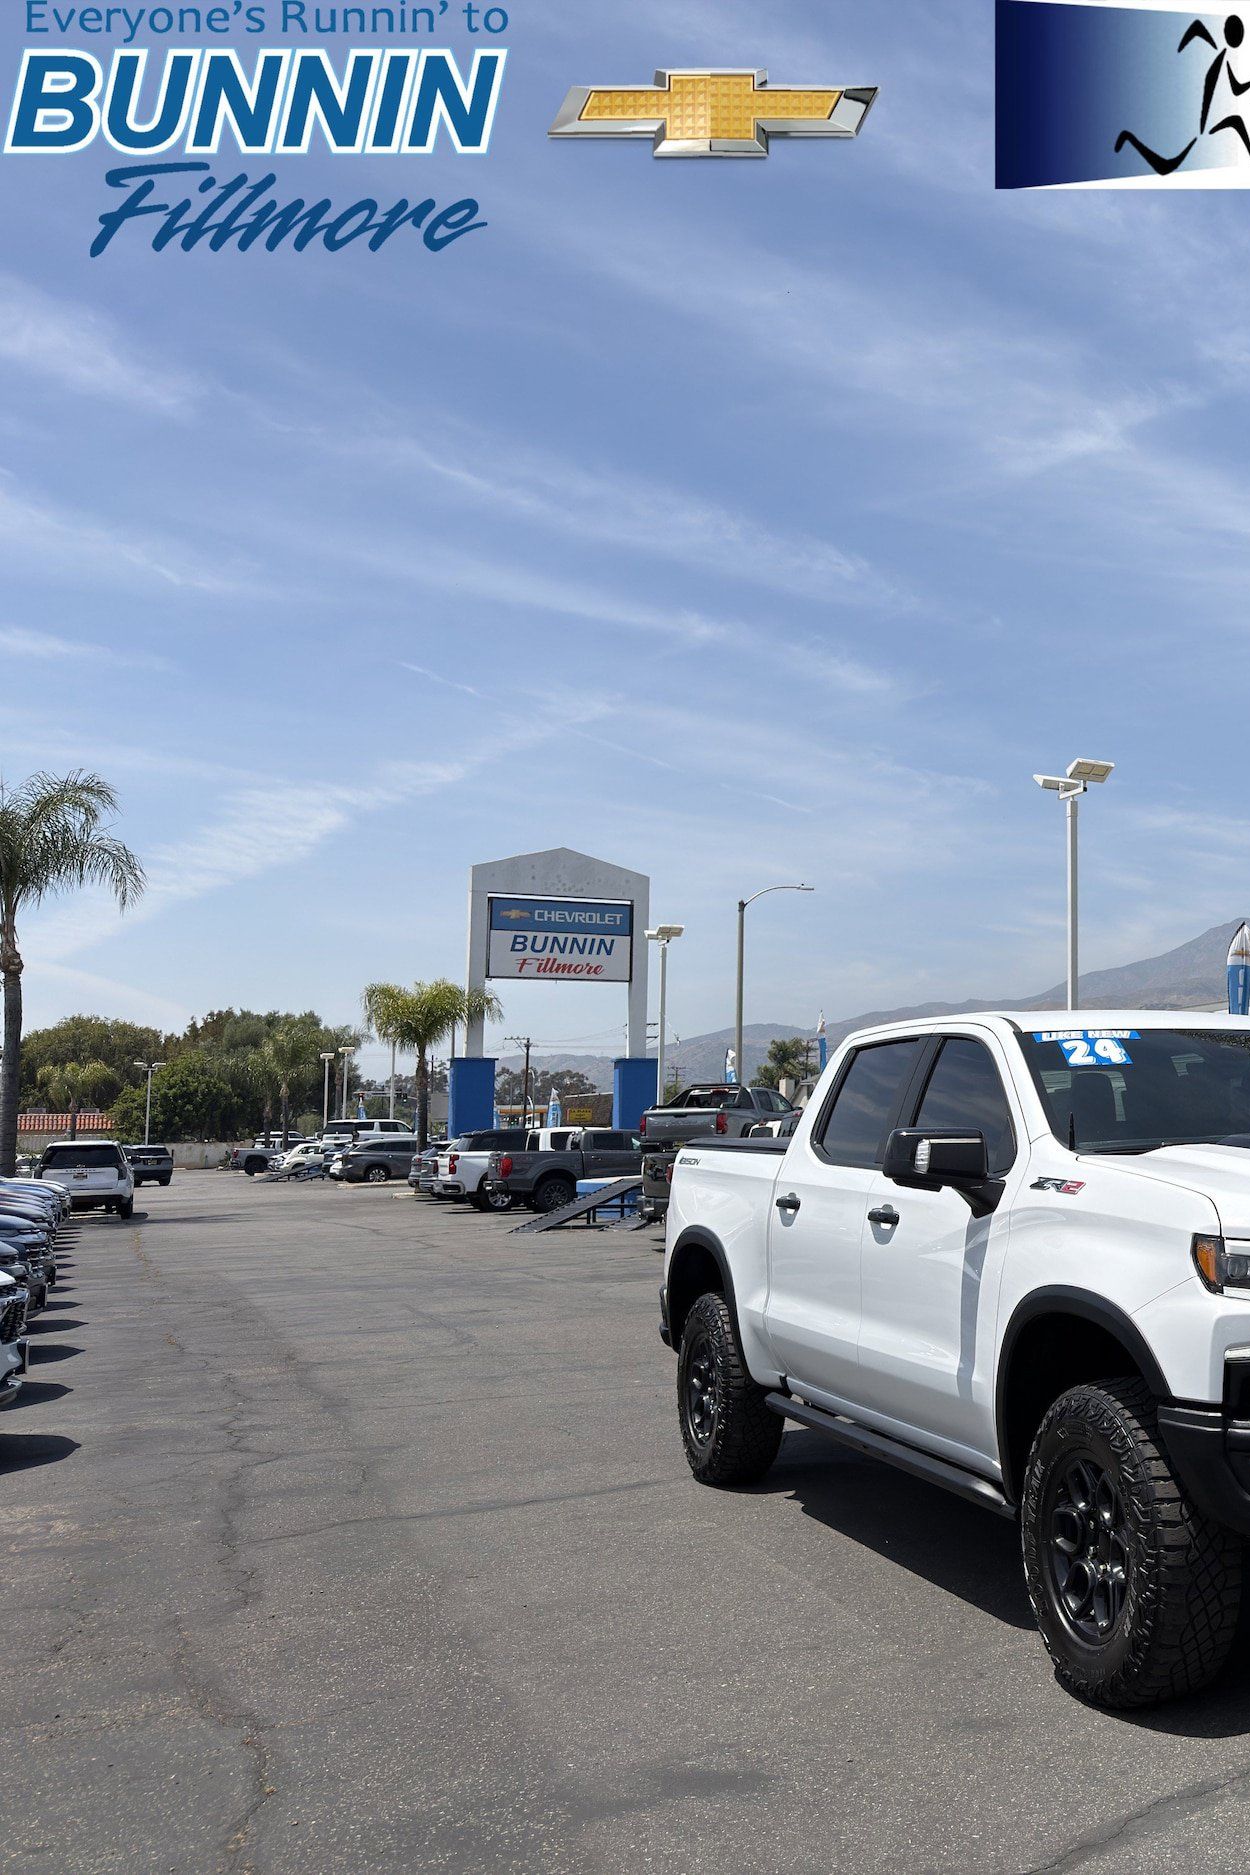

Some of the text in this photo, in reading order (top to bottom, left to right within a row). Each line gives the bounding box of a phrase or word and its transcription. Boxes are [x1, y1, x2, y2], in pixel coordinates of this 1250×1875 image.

[534, 909, 624, 926] CHEVROLET
[510, 934, 615, 956] BUNNIN
[515, 957, 604, 976] Fillmore
[1062, 1038, 1127, 1065] 24
